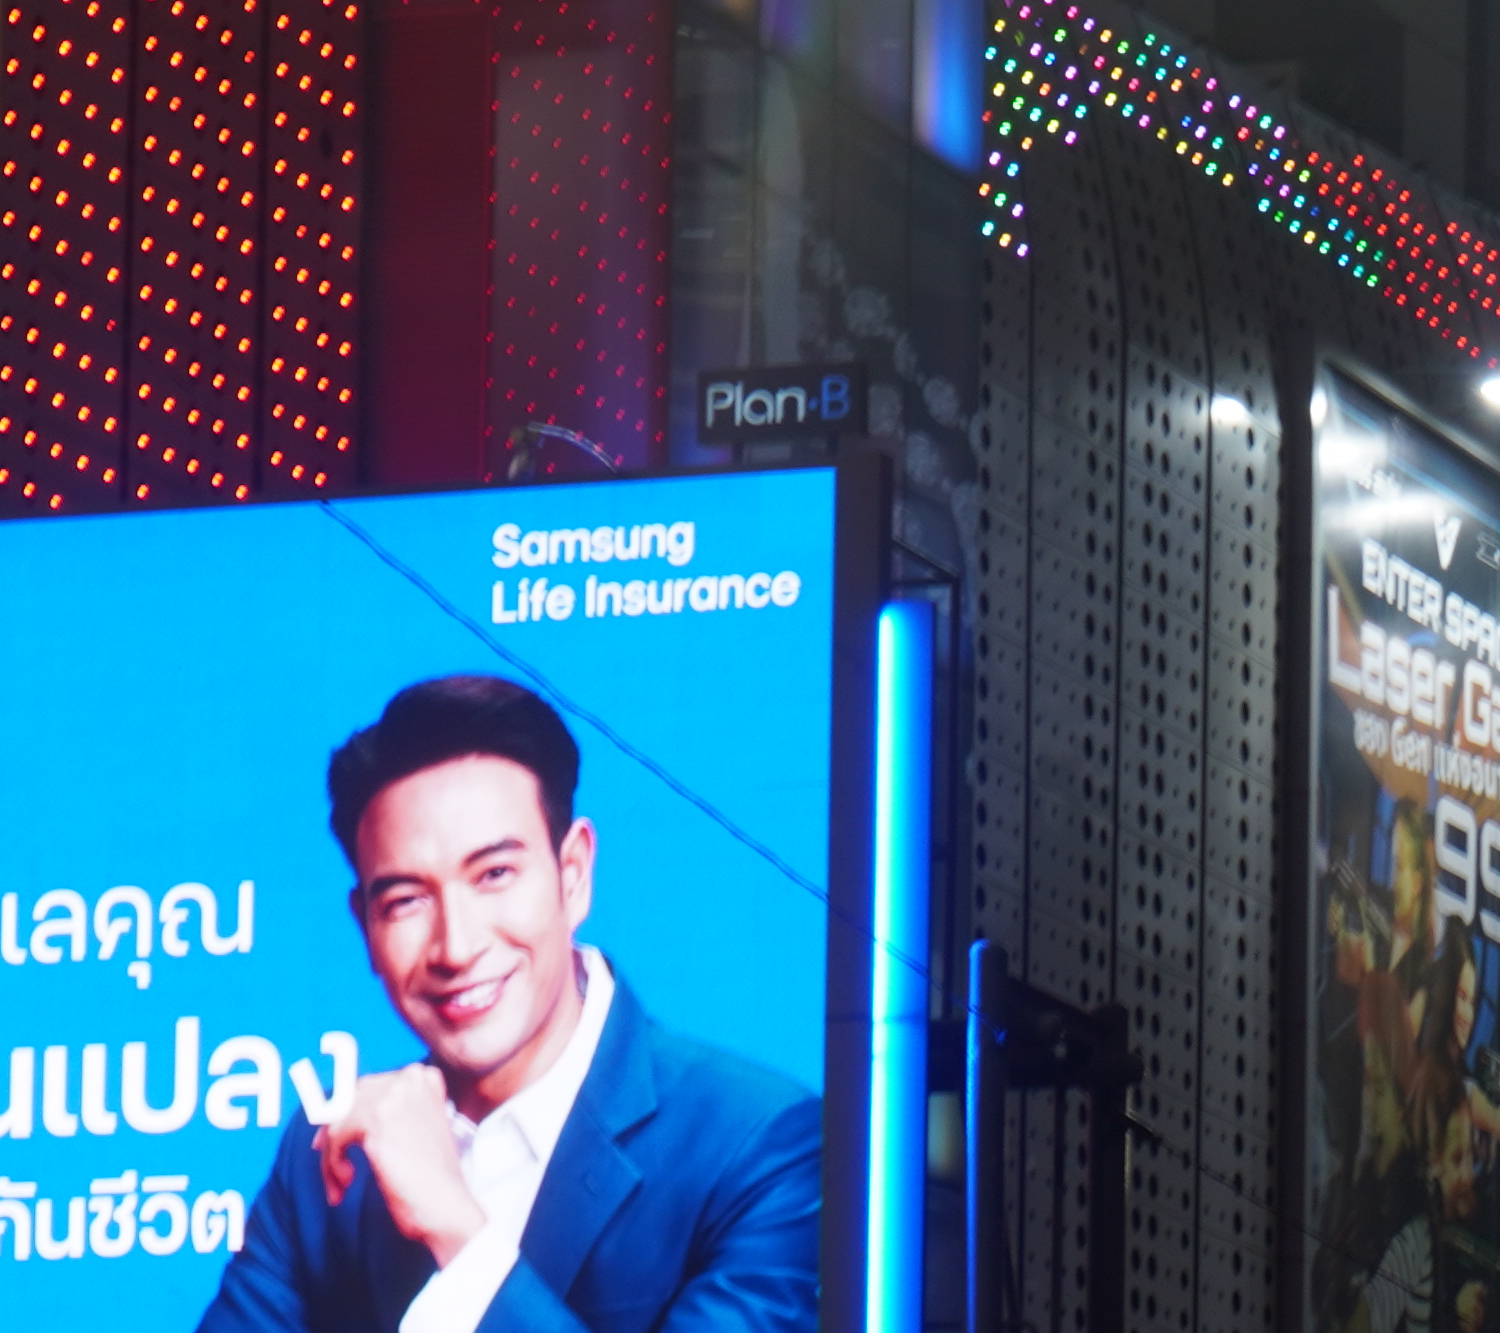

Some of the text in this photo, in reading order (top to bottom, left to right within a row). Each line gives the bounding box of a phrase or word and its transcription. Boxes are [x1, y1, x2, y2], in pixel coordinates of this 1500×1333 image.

[492, 518, 696, 570] Samsung
[491, 570, 802, 624] Life Insurance
[1361, 537, 1442, 635] ENTER
[1327, 583, 1457, 733] Laser
